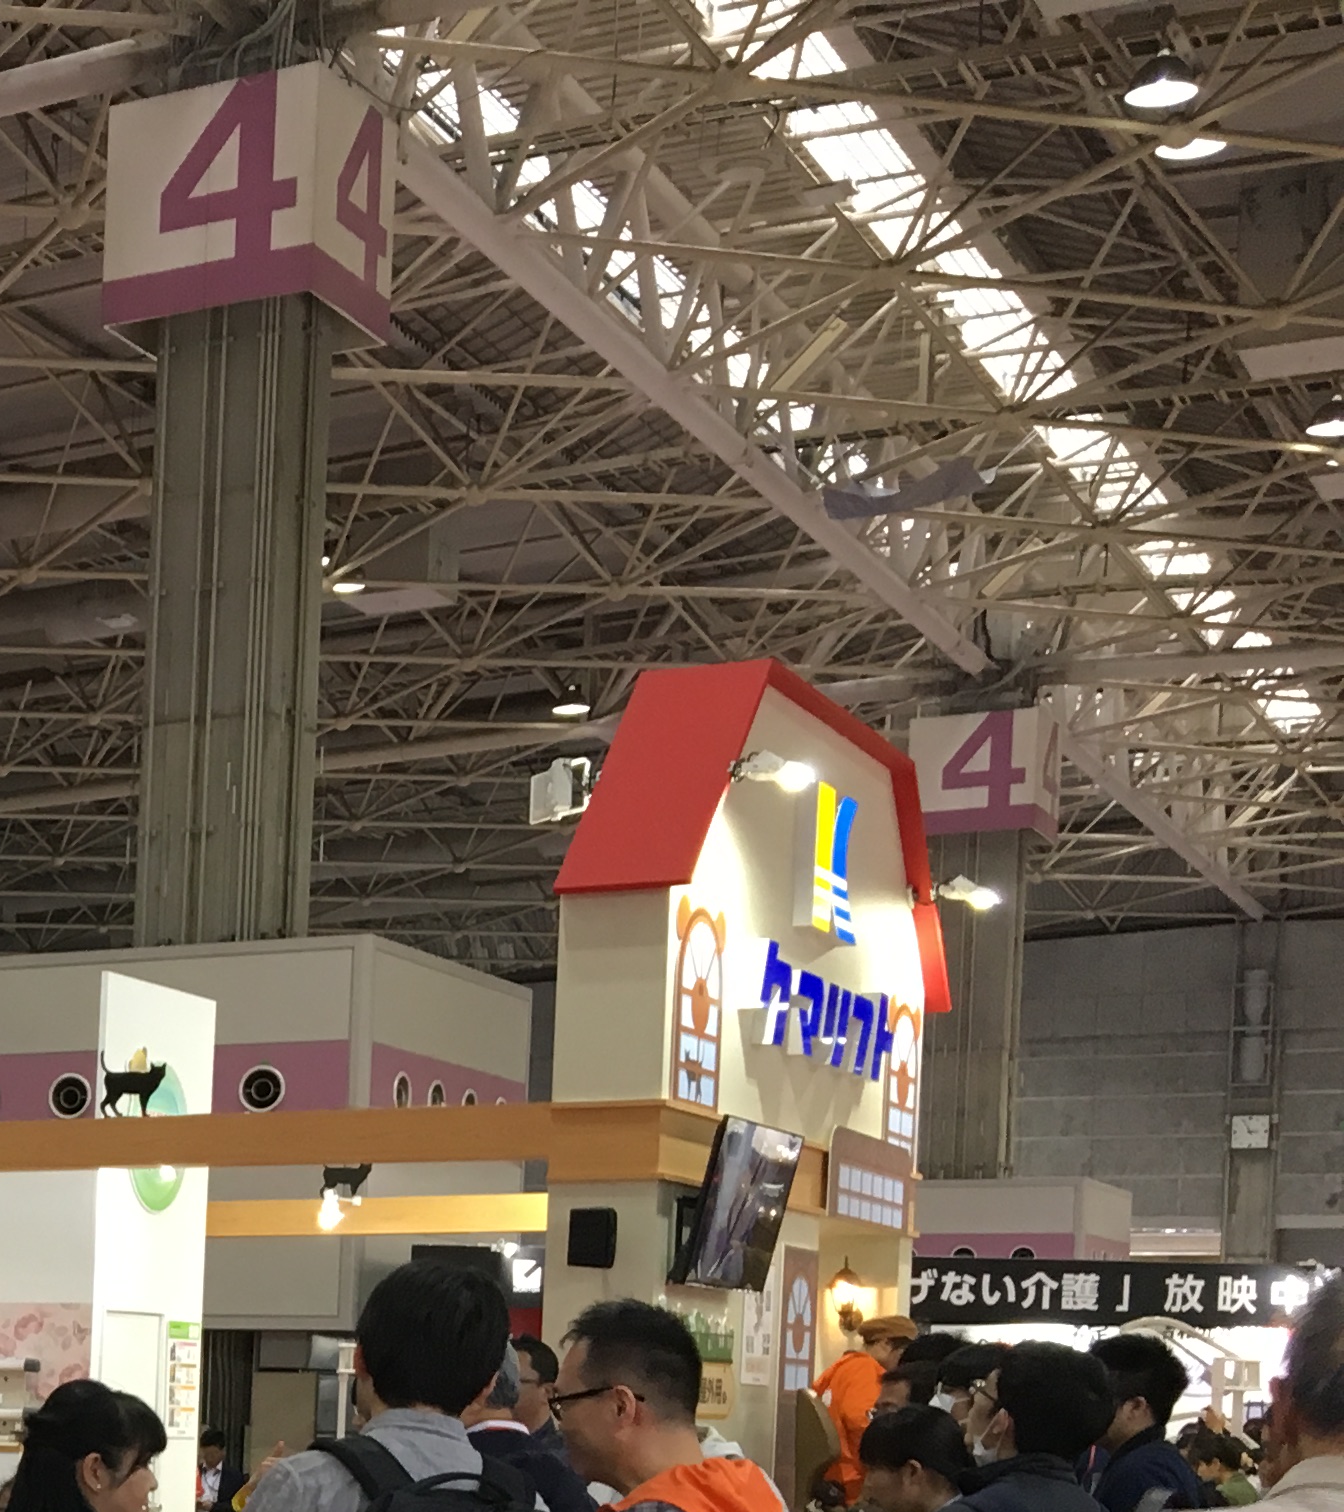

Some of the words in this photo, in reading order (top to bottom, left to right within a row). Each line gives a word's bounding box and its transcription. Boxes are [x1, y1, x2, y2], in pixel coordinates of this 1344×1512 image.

[159, 70, 298, 257] 4
[336, 105, 388, 293] 4
[942, 710, 1026, 807] 4
